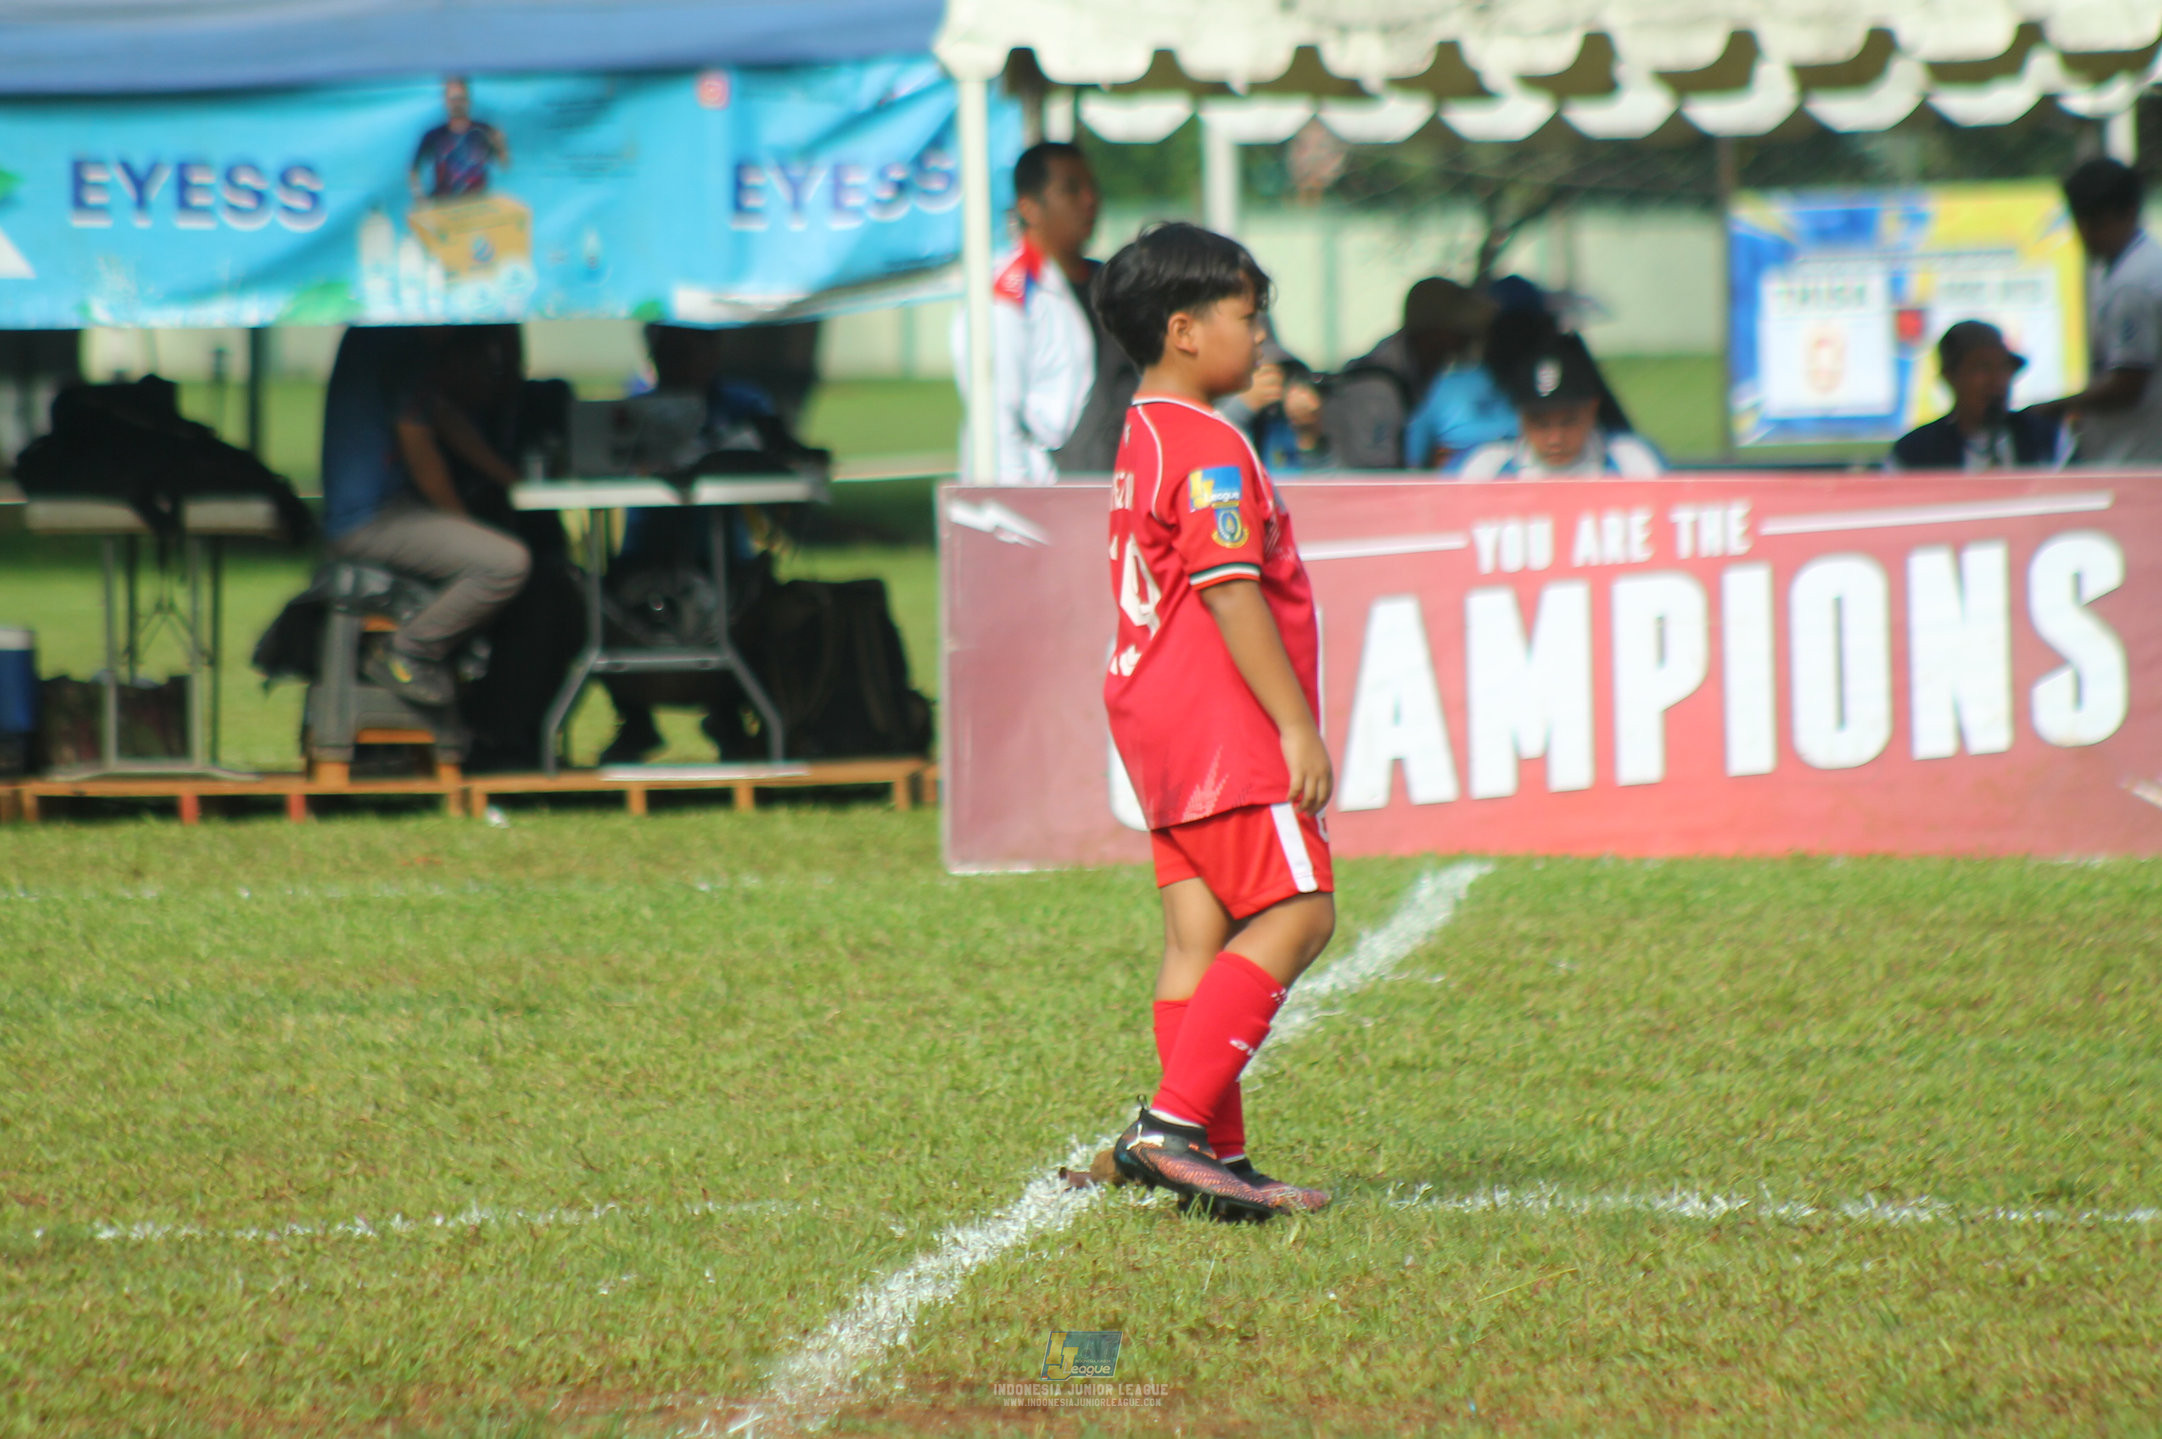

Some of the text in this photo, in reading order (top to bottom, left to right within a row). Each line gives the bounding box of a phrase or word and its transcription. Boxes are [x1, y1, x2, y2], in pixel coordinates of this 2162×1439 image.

[70, 156, 327, 232] EYESS
[730, 147, 963, 232] EYESS
[1472, 498, 1753, 575] YOU ARE THE
[1108, 528, 2129, 832] AMPIONS
